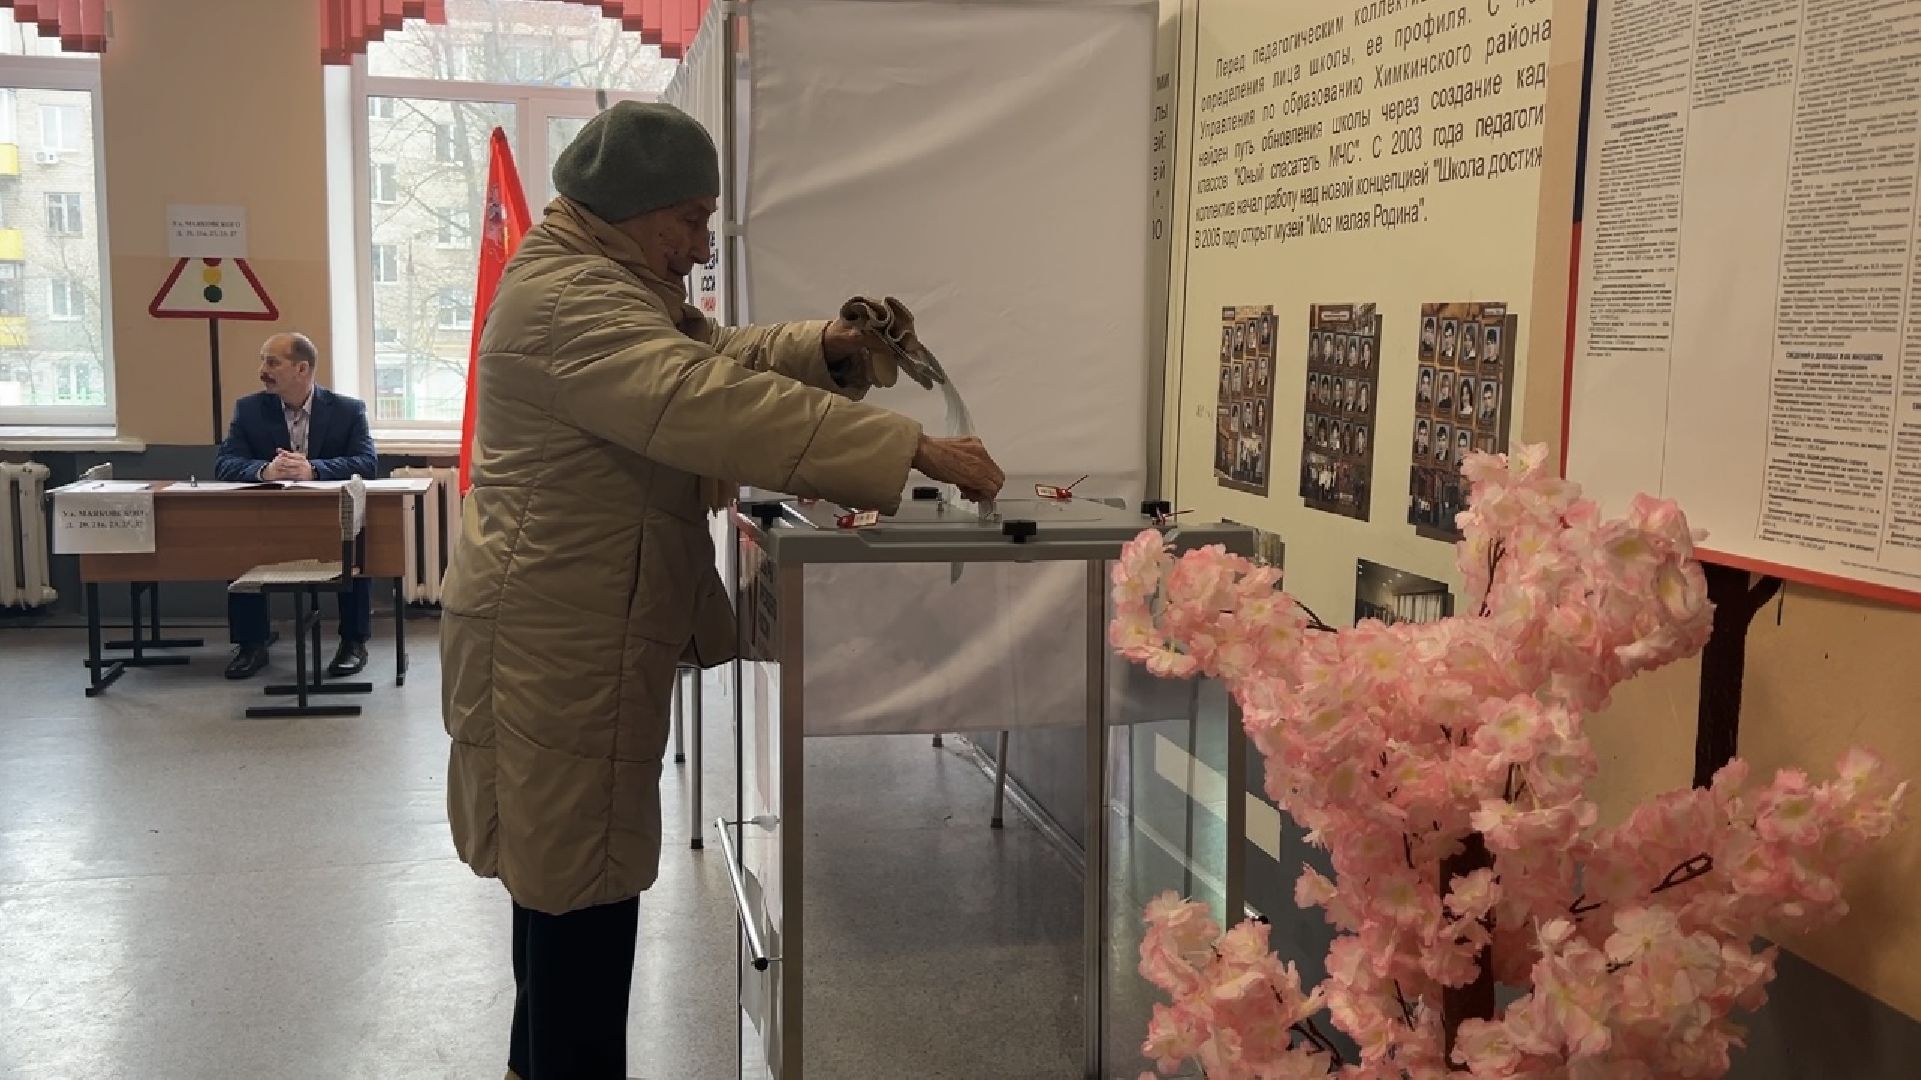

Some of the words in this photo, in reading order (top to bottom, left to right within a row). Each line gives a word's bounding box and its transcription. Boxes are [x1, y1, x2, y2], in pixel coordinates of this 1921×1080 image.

[1216, 54, 1245, 78] Перед
[1253, 16, 1344, 65] педагогическим
[1273, 64, 1300, 88] лица
[1310, 46, 1355, 76] школы,
[1366, 35, 1383, 56] ее
[1395, 6, 1471, 51] профиля.
[1200, 109, 1255, 139] Управления
[1262, 103, 1275, 121] по
[1283, 76, 1363, 117] образованию
[1374, 43, 1471, 89] Химкинского
[1485, 18, 1552, 64] района
[1234, 140, 1255, 161] путь
[1262, 121, 1322, 151] обновления
[1332, 109, 1371, 134] школы
[1381, 96, 1419, 124] через
[1431, 73, 1502, 109] создание
[1516, 62, 1549, 90] кад
[1271, 154, 1320, 180] спасатель
[1329, 138, 1362, 167] МЧС".
[1372, 135, 1382, 159] С
[1391, 124, 1422, 155] 2003
[1433, 122, 1464, 148] года
[1237, 197, 1263, 215] начал
[1264, 188, 1298, 215] работу
[1300, 185, 1319, 206] над
[1321, 175, 1354, 200] новой
[1355, 160, 1429, 196] концепцией
[1433, 156, 1485, 183] "Школа
[1274, 215, 1303, 243] музей
[1306, 212, 1332, 235] "Моя
[1335, 211, 1370, 232] малая
[1374, 197, 1427, 231] Родина".
